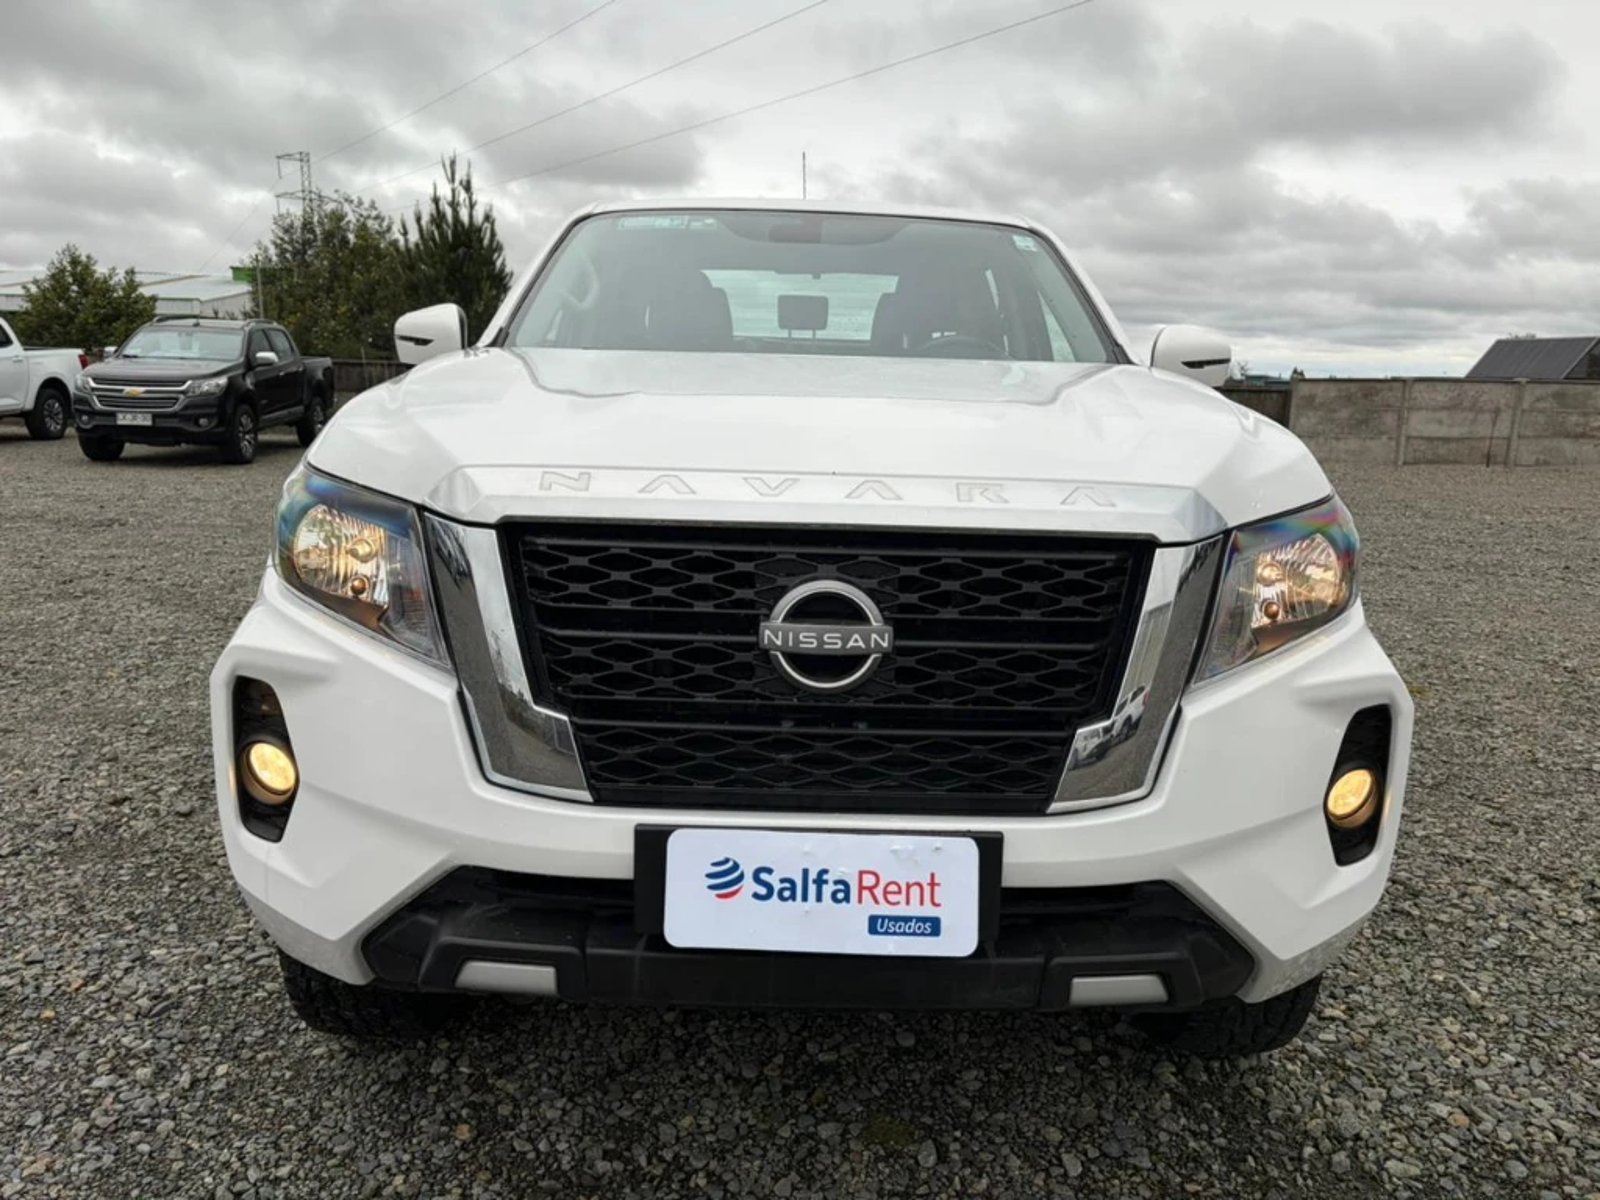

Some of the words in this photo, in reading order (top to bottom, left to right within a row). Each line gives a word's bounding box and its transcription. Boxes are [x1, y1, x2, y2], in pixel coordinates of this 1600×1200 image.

[539, 470, 1117, 507] NAVARA
[763, 629, 889, 649] NISSAN
[751, 866, 942, 907] SalfaRent
[876, 917, 932, 935] Usados
